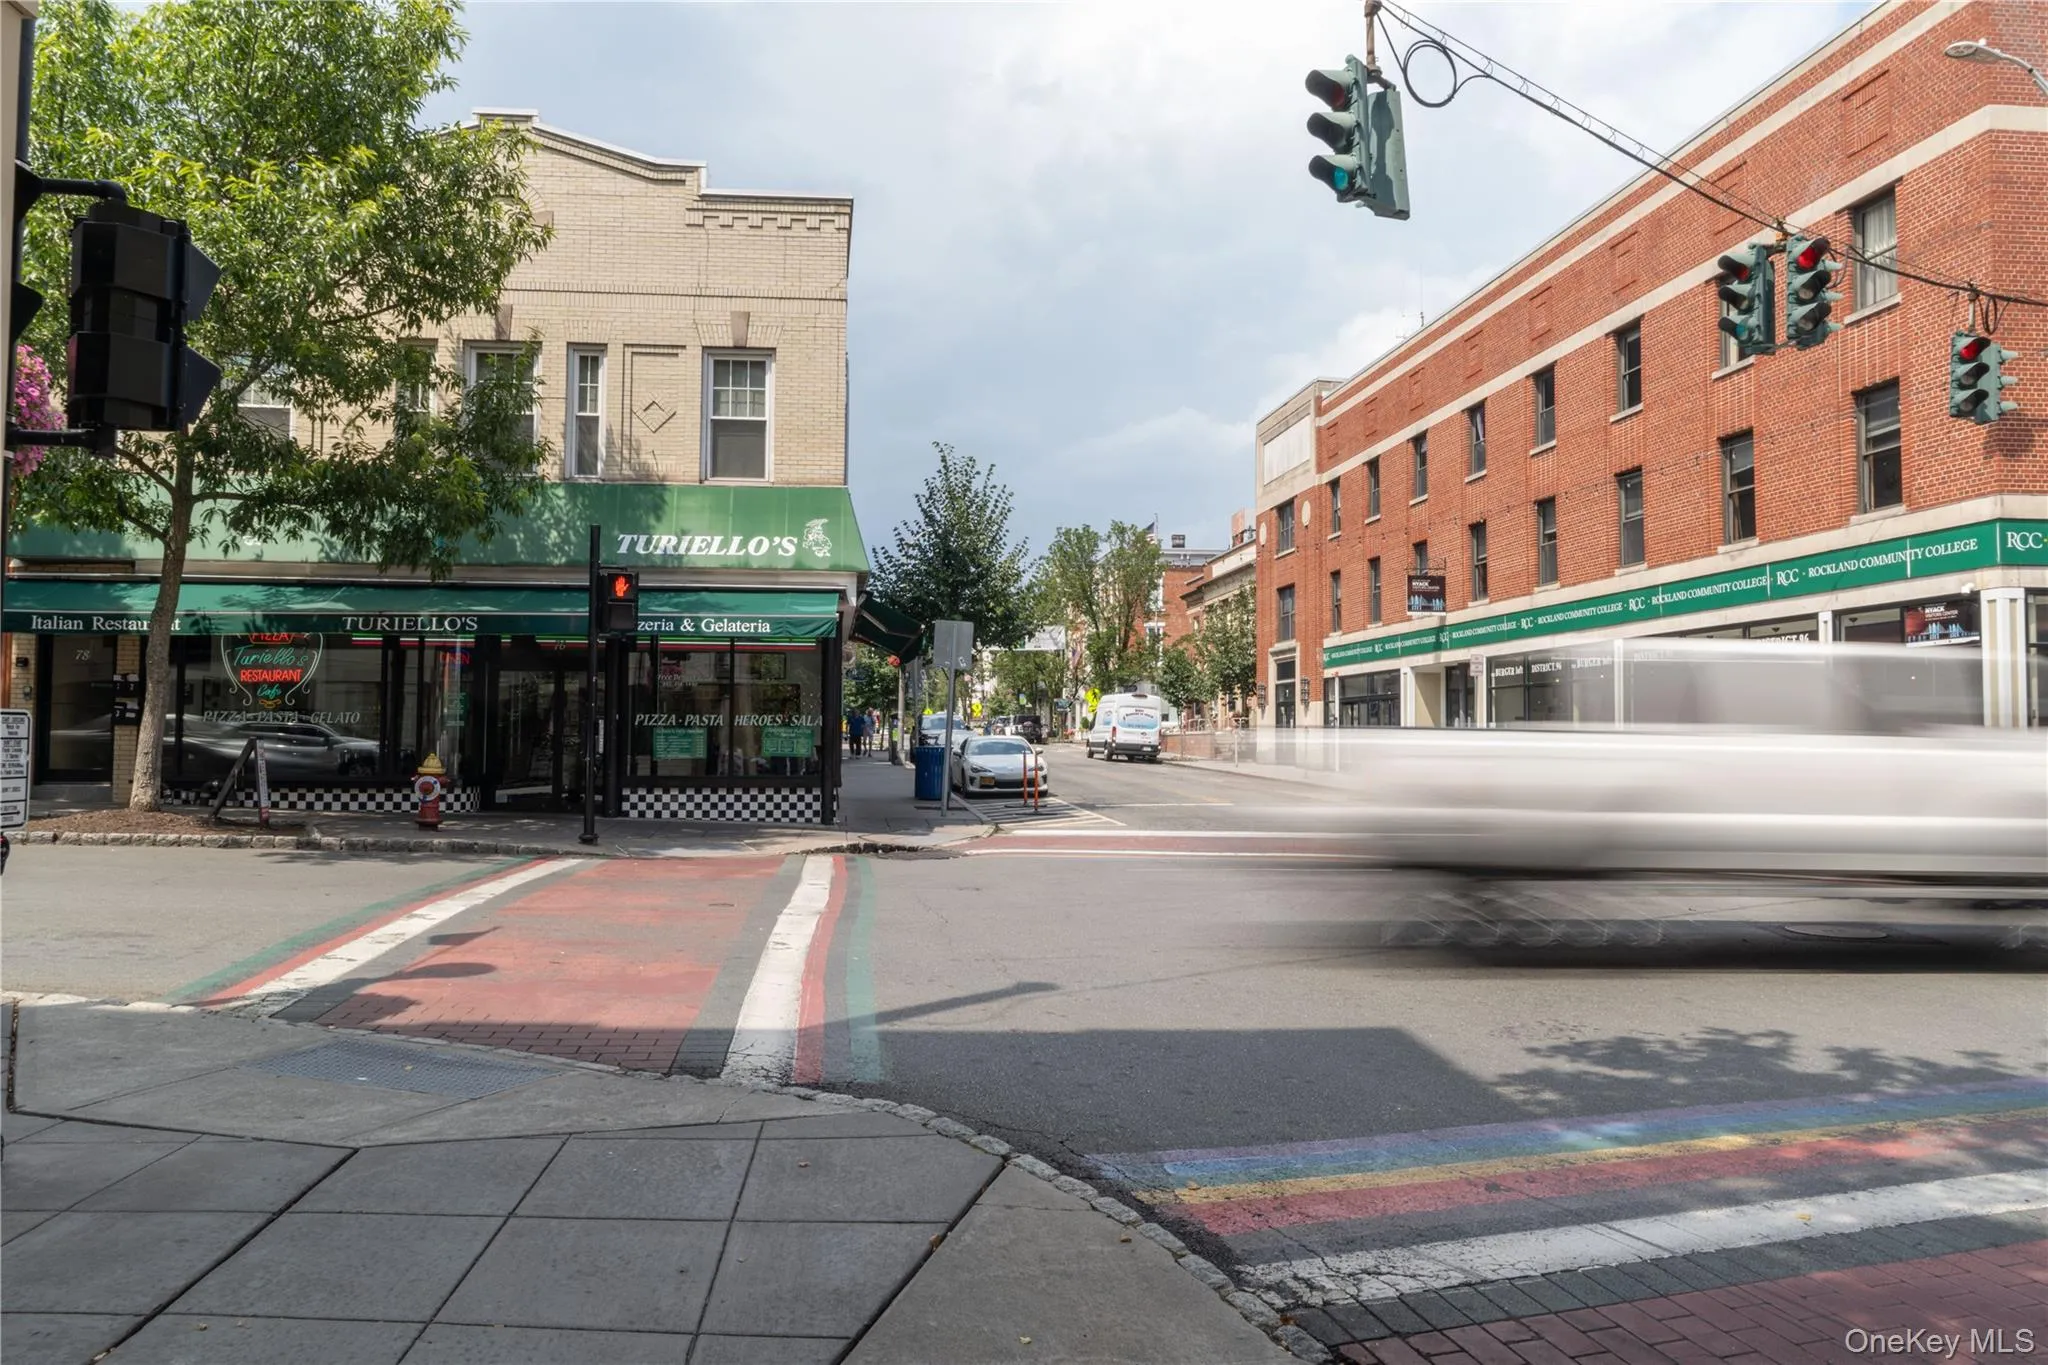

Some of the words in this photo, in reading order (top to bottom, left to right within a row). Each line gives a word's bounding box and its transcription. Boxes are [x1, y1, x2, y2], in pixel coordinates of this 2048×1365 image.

[616, 533, 799, 557] TURIELLO'S
[2006, 532, 2043, 551] RCC
[1776, 569, 1799, 586] RCC
[1807, 560, 1858, 578] ROCKLAND
[1859, 547, 1925, 568] COMMUNITY
[1925, 538, 1978, 557] COLLEGE
[1628, 597, 1645, 611] RCC
[1651, 590, 1687, 605] ROCKLAND
[1687, 582, 1732, 599] COMMUNITY
[1732, 576, 1768, 591] COLLEGE
[31, 614, 84, 631] Italian
[342, 616, 479, 631] TURIELLO'S
[637, 618, 674, 632] zeria
[680, 617, 695, 632] &
[701, 617, 771, 632] Gelateria
[74, 650, 90, 661] 78
[240, 668, 303, 682] RESTAURANT
[203, 711, 247, 723] PIZZA
[257, 711, 299, 723] PASTA
[310, 712, 361, 724] GELATO
[634, 714, 677, 726] PIZZA
[684, 714, 725, 727] PASTA
[734, 714, 783, 727] HEROES
